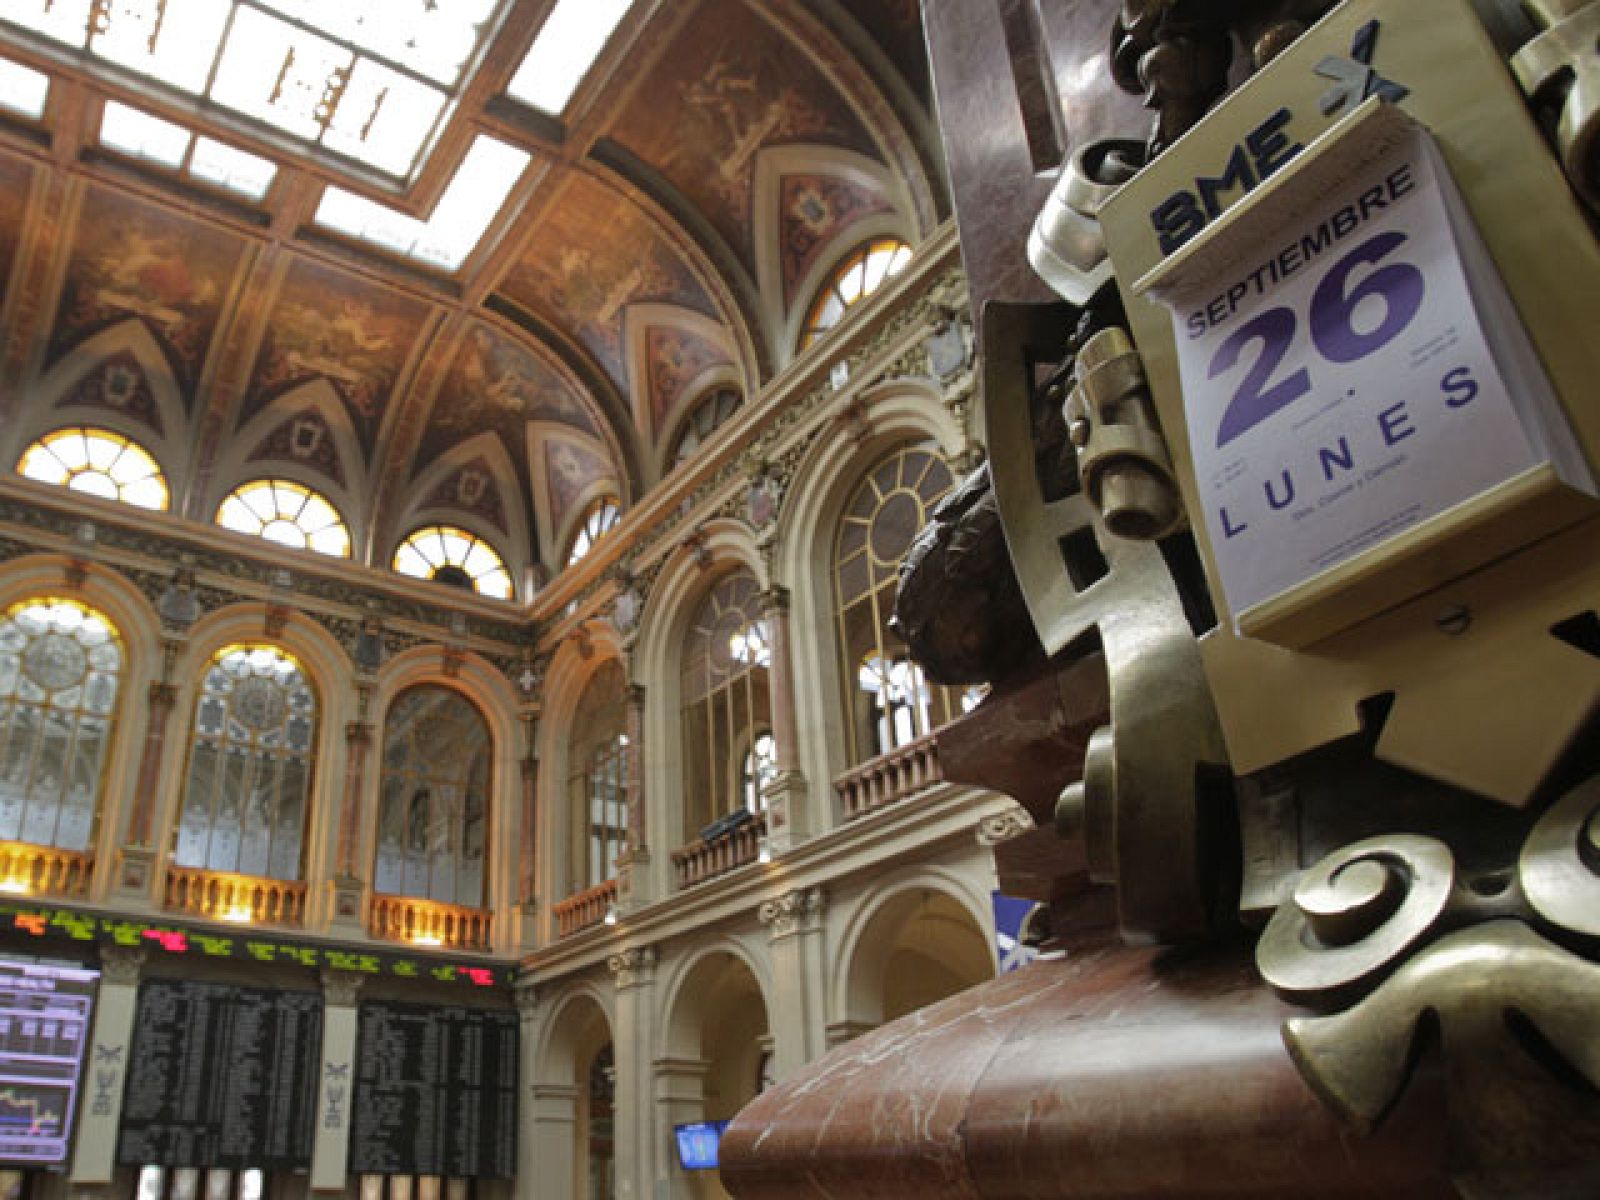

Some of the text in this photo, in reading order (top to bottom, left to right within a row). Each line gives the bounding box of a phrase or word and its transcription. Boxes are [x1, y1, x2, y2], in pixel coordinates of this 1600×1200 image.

[1152, 107, 1304, 254] BME
[1187, 164, 1415, 339] SEPTIEMBRE
[1207, 231, 1425, 449] 26
